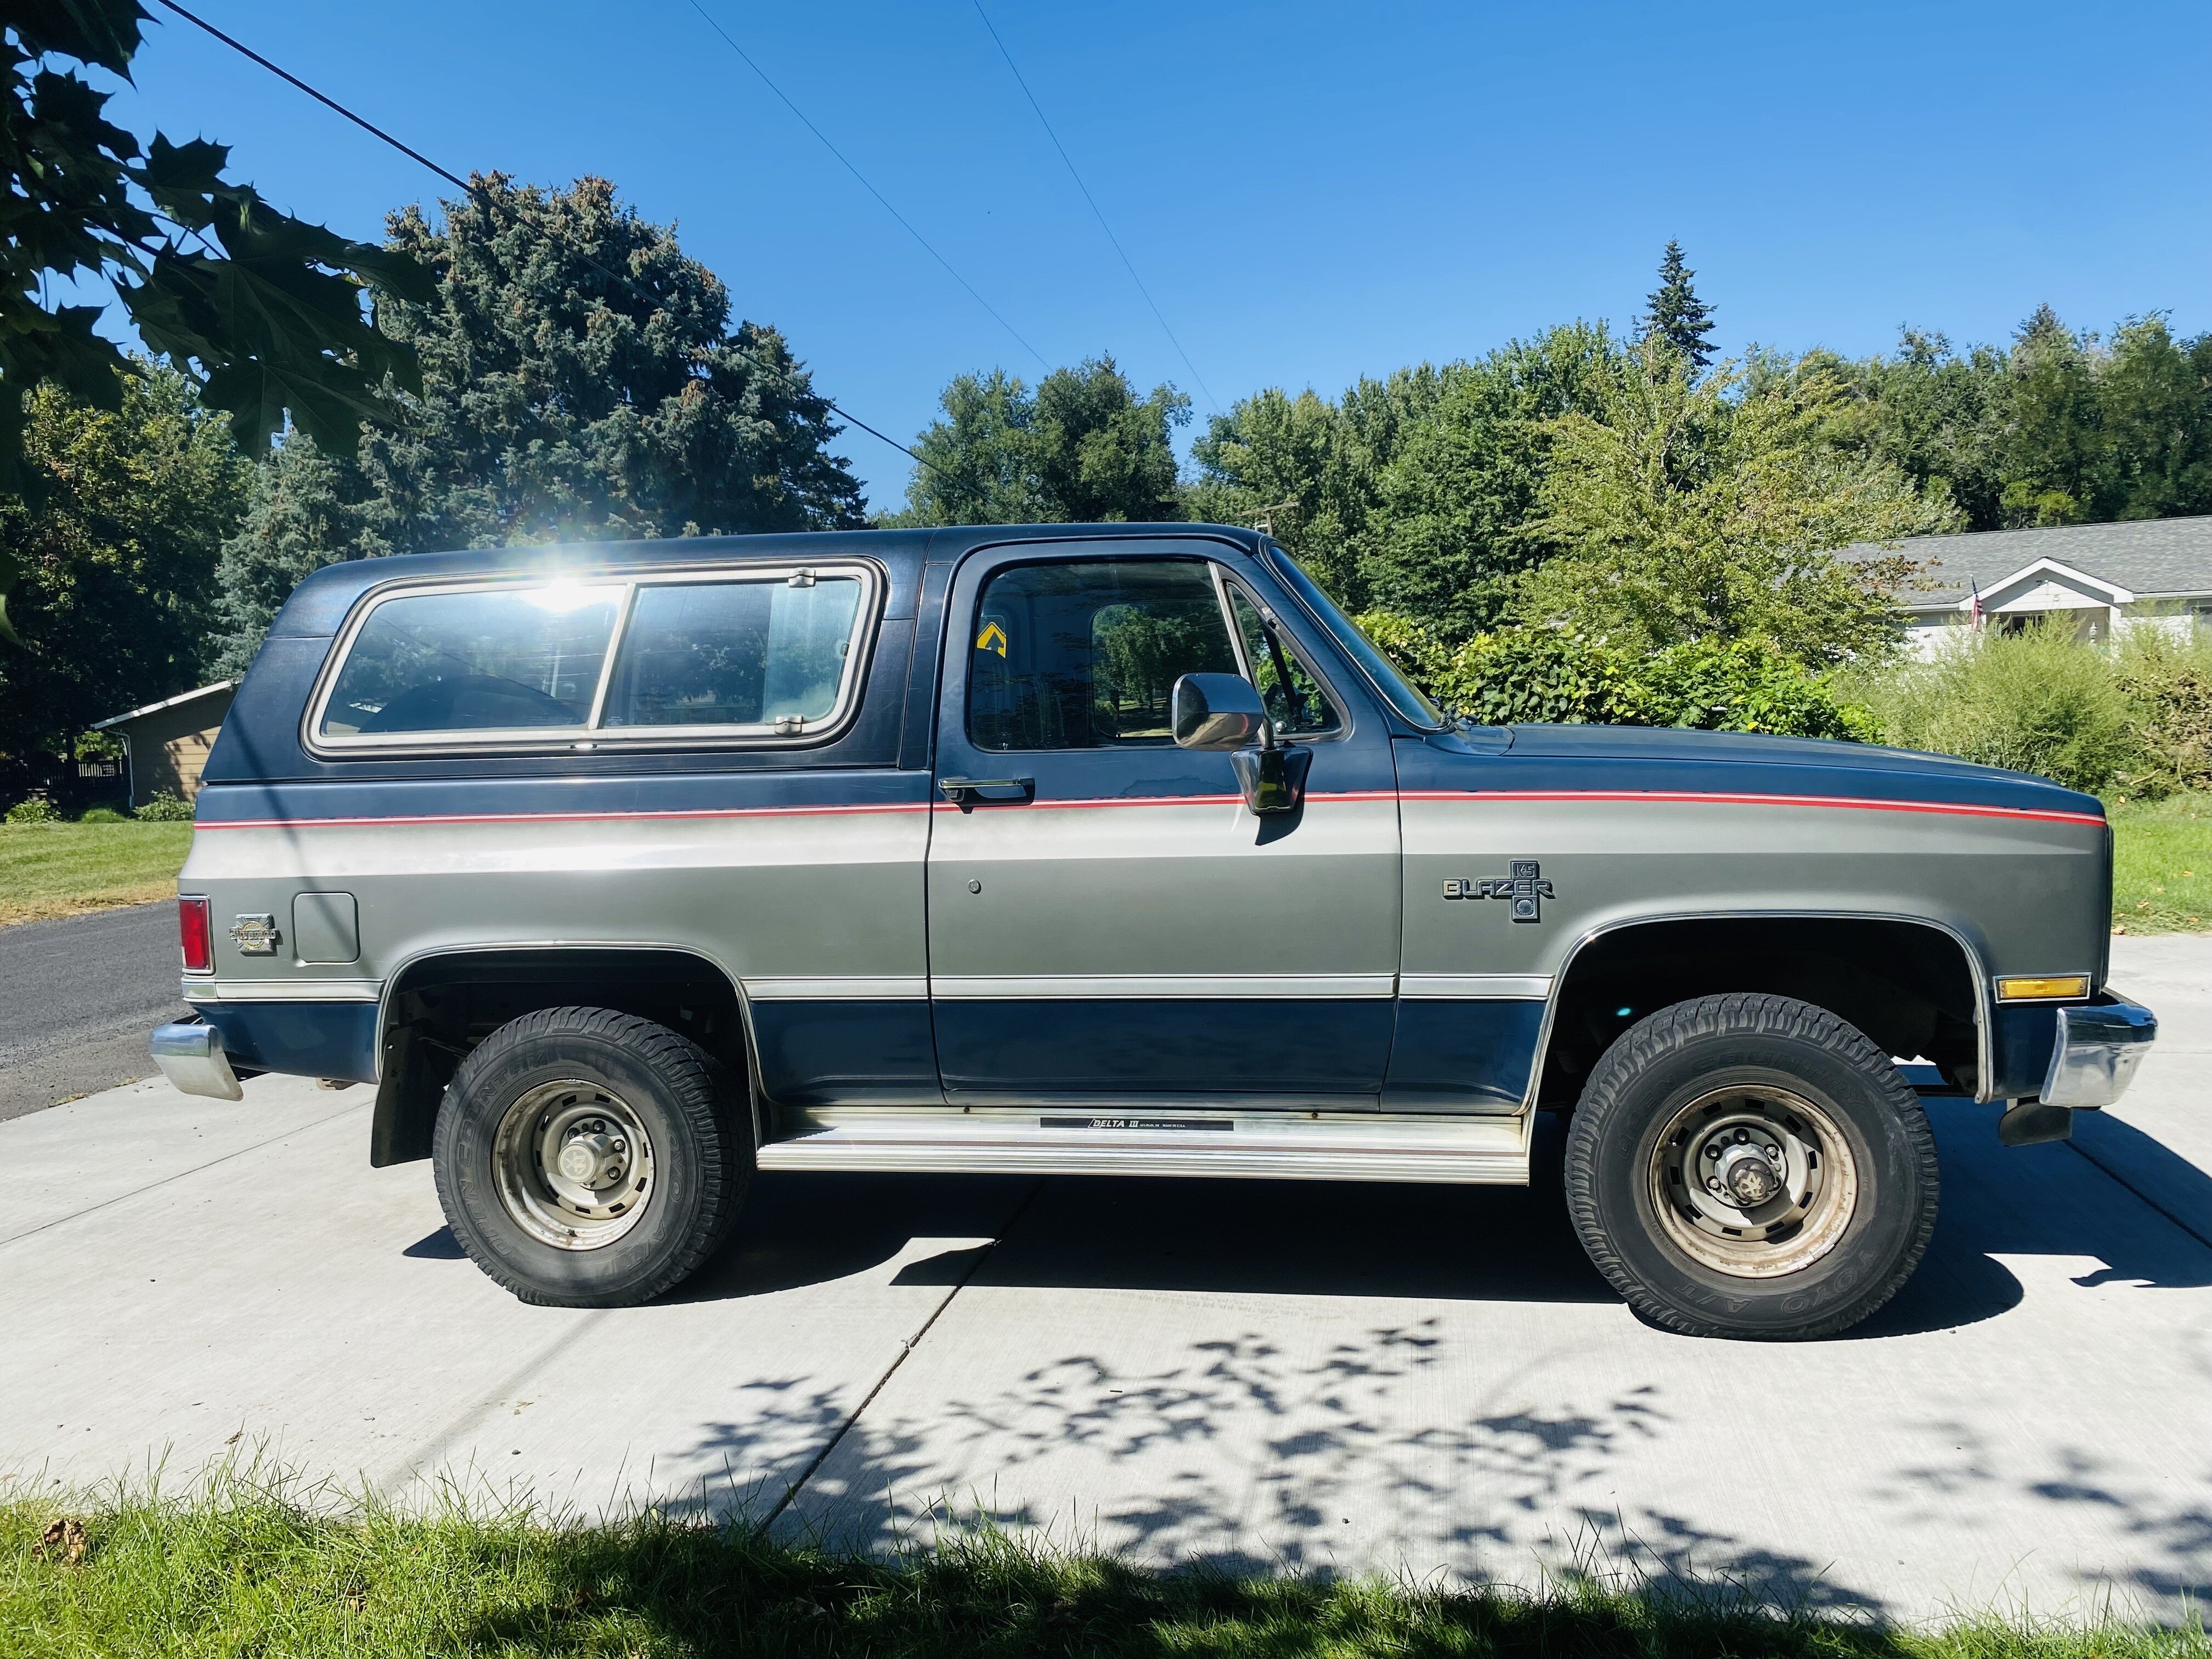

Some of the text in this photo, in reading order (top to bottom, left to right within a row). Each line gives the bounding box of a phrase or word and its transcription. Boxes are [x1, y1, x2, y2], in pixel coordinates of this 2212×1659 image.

[1442, 879, 1556, 899] BLAZER
[1514, 864, 1536, 878] K5
[1691, 1051, 1865, 1107] COUNTRY
[1090, 1119, 1125, 1127] DELTA
[459, 1051, 548, 1256] OPEN COUNTRY
[656, 1104, 682, 1201] TOYO
[1782, 1251, 1876, 1314] TOYO
